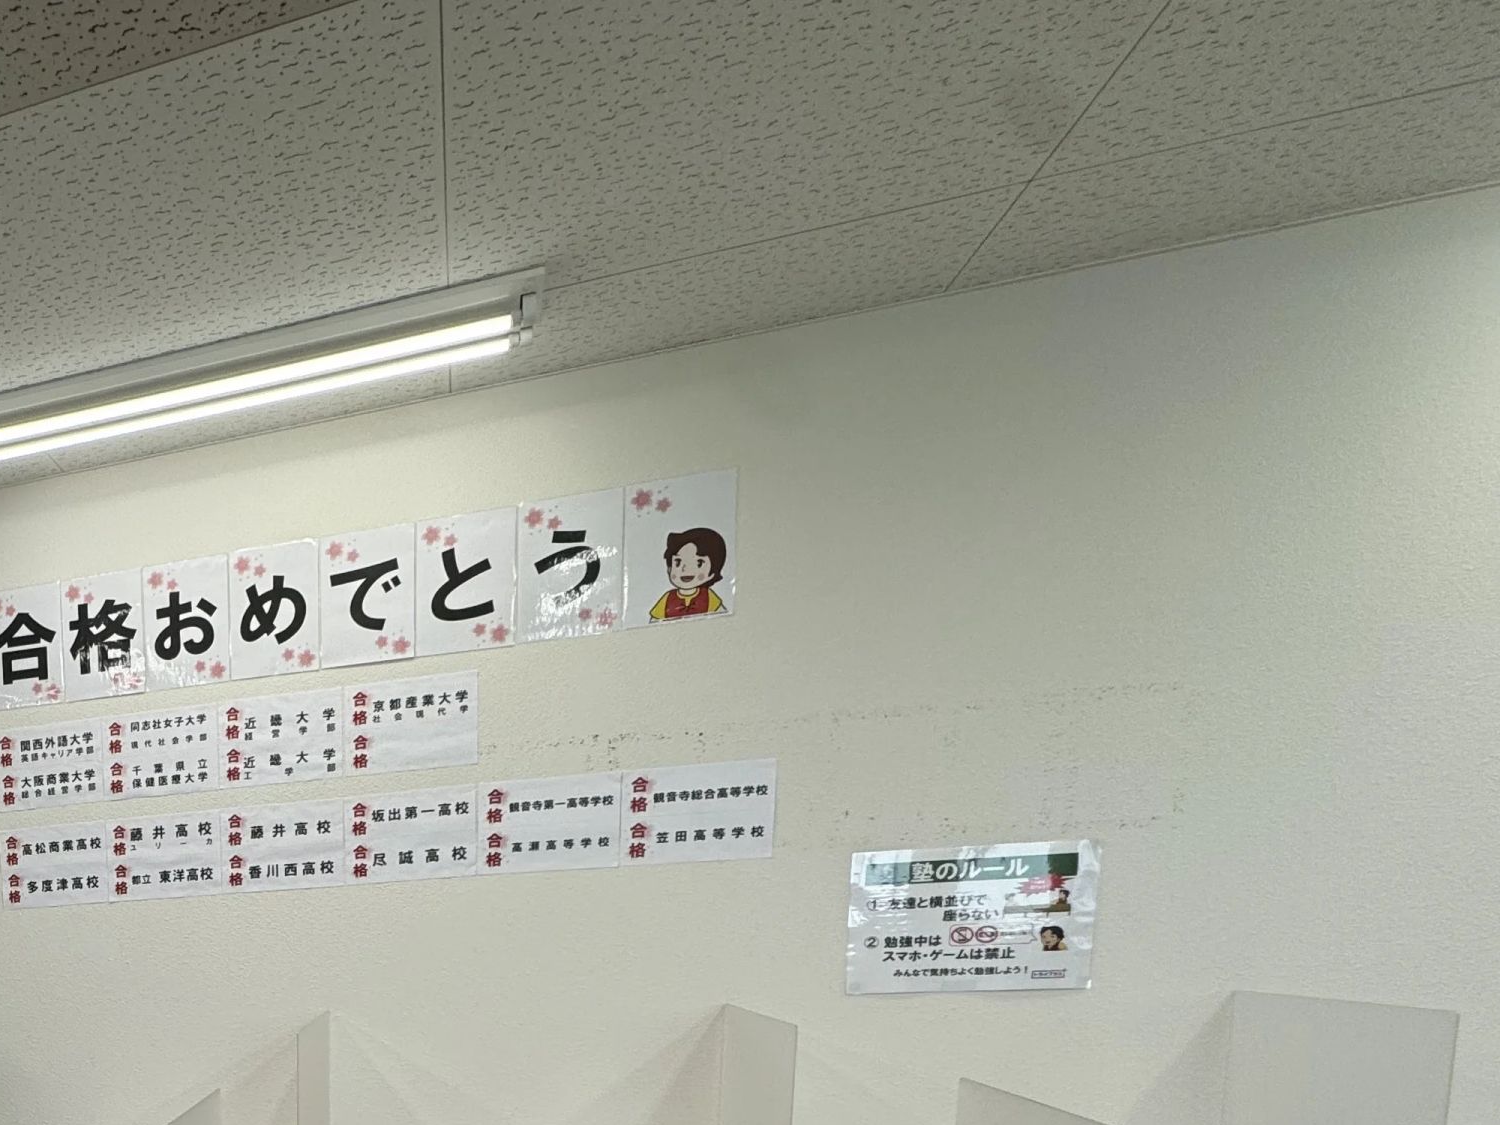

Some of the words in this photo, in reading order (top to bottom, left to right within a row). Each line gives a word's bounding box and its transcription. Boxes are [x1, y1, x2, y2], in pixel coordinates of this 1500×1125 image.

[353, 692, 368, 726] 合格
[373, 689, 468, 713] 京都産業大学
[130, 714, 207, 732] 同志社女子大学
[226, 707, 240, 740] 合格
[244, 707, 335, 730] 近畿大学
[0, 736, 13, 767] 合格
[20, 732, 94, 752] 関西外語大学
[109, 722, 123, 754] 合格
[353, 735, 368, 769] 合格
[21, 769, 95, 789] 大阪商業大学
[110, 763, 124, 794] 合格
[227, 748, 241, 782] 合格
[2, 775, 15, 805] 合格
[132, 772, 208, 789] 保健医療大学
[630, 777, 648, 813] 合格
[654, 784, 769, 803] 観音寺総合高等学校
[352, 802, 367, 837] 合格
[371, 801, 470, 822] 坂出第一高校
[487, 789, 504, 824] 合格
[113, 825, 126, 856] 合格
[130, 821, 212, 842] 藤井高校
[228, 814, 242, 846] 合格
[250, 820, 331, 839] 藤井高校
[629, 823, 647, 858] 合格
[656, 825, 765, 844] 笠田高等学校
[6, 836, 18, 866] 合格
[21, 837, 102, 856] 高松商業高校
[372, 846, 467, 867] 尽誠高校
[486, 833, 503, 867] 合格
[159, 867, 213, 884] 東洋高校
[229, 855, 243, 887] 合格
[249, 860, 334, 880] 香川西高校
[353, 845, 368, 878] 合格
[911, 858, 1029, 882] 塾のルール
[8, 874, 21, 903] 合格
[27, 875, 100, 894] 多度津高校
[114, 864, 128, 895] 合格
[942, 909, 999, 922] 座らない
[882, 946, 1016, 961] スマホ・ゲームは禁止
